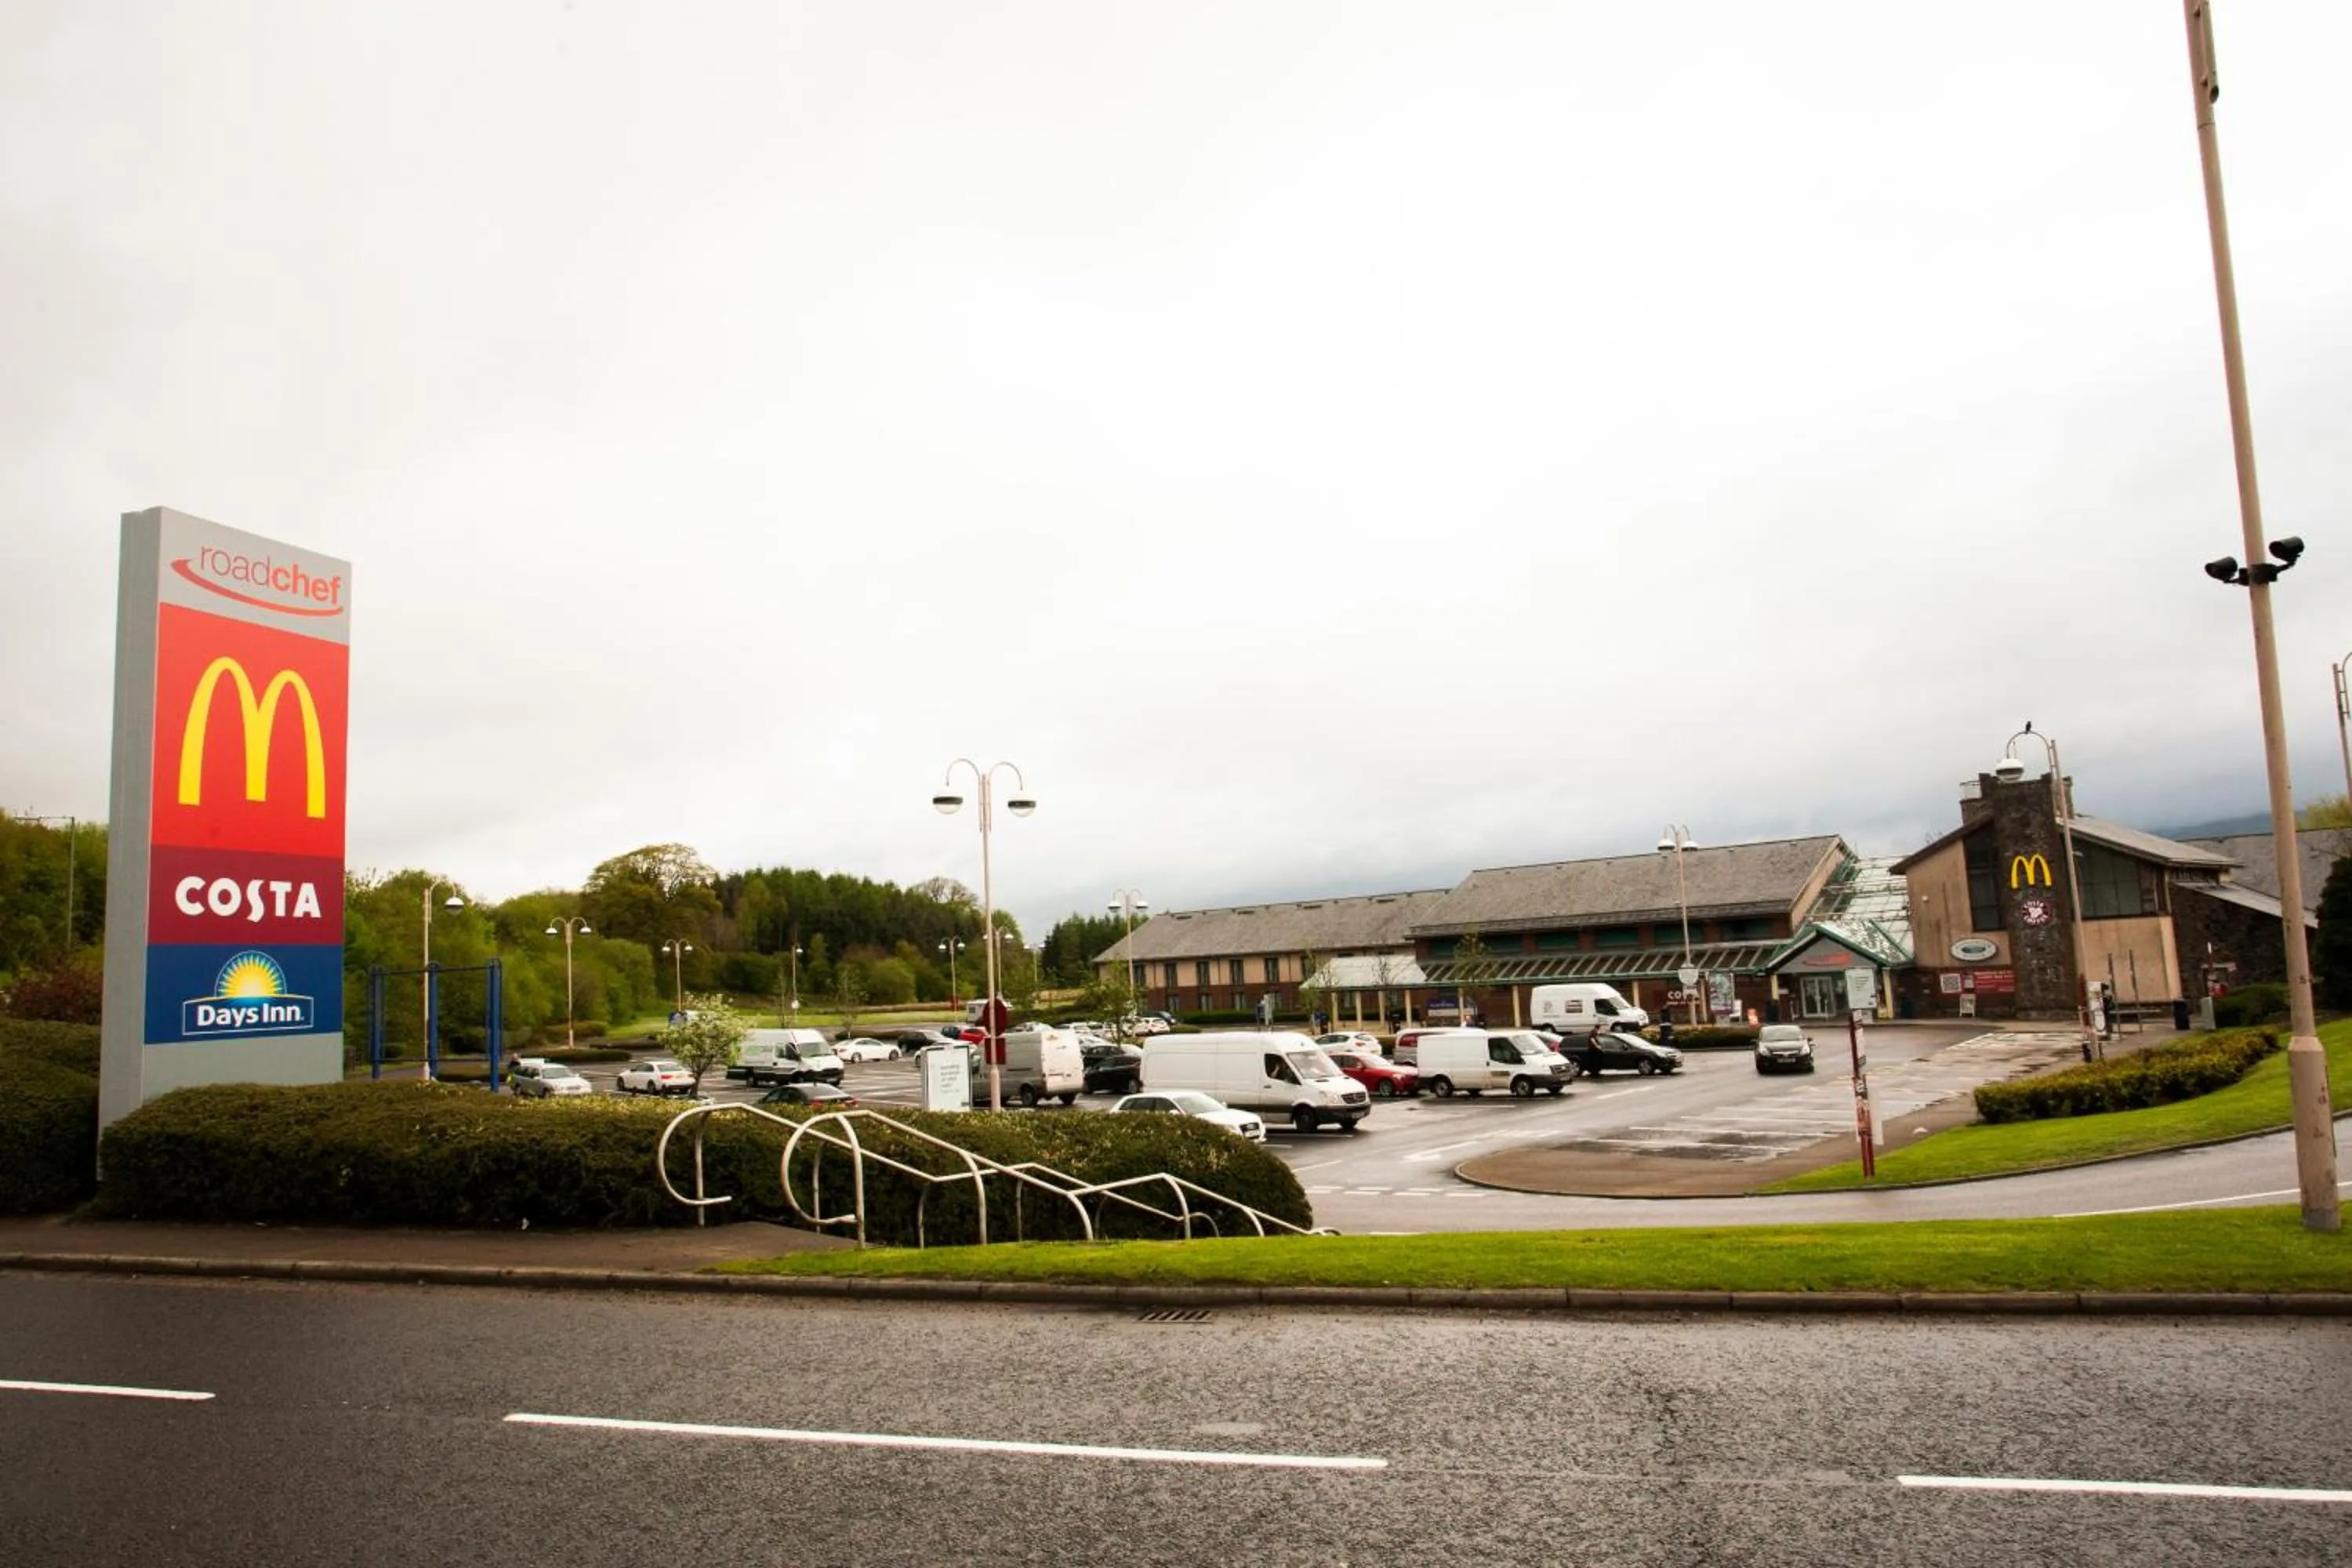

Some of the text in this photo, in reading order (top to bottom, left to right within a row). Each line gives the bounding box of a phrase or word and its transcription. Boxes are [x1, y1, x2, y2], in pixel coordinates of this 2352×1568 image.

[200, 545, 341, 604] roadchef
[174, 875, 322, 923] COSTA
[197, 1003, 301, 1028] Days Inn
